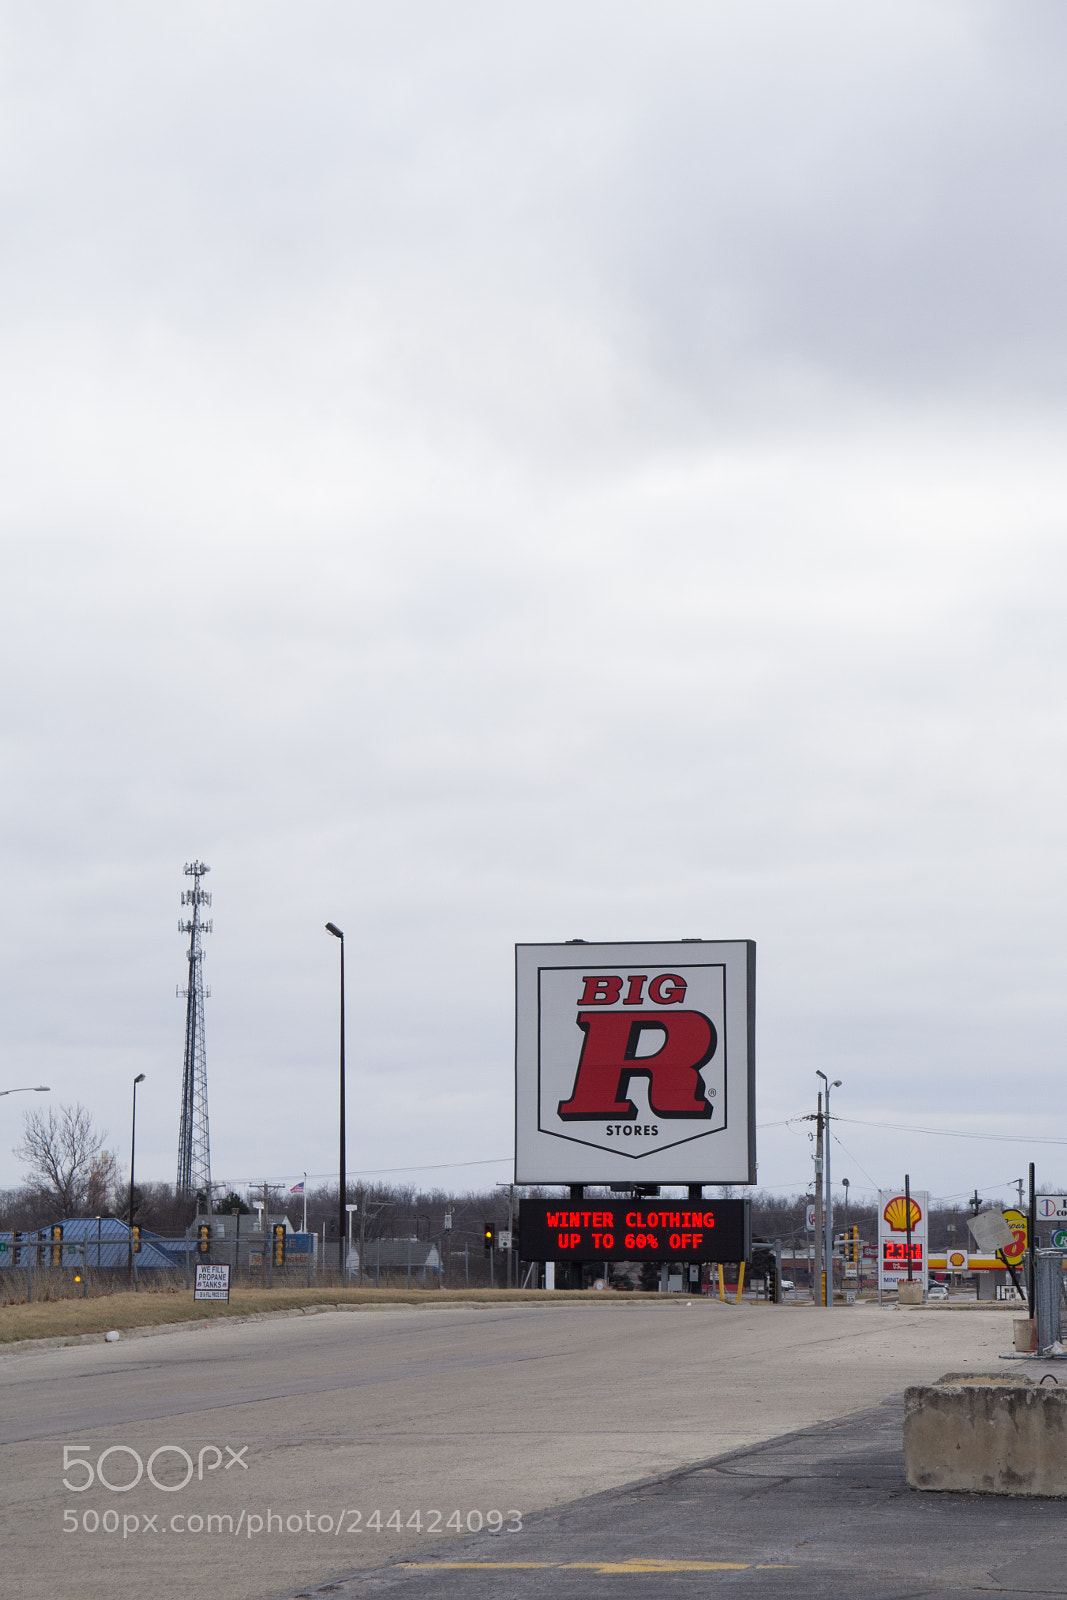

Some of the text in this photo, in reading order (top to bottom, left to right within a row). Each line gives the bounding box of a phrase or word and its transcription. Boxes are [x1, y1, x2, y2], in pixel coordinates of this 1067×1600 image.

[577, 973, 688, 1006] BIG
[557, 1009, 718, 1122] R
[606, 1125, 659, 1136] STORES
[547, 1212, 715, 1228] WINTER CLOTHING
[558, 1233, 703, 1249] UP TO 60% OFF
